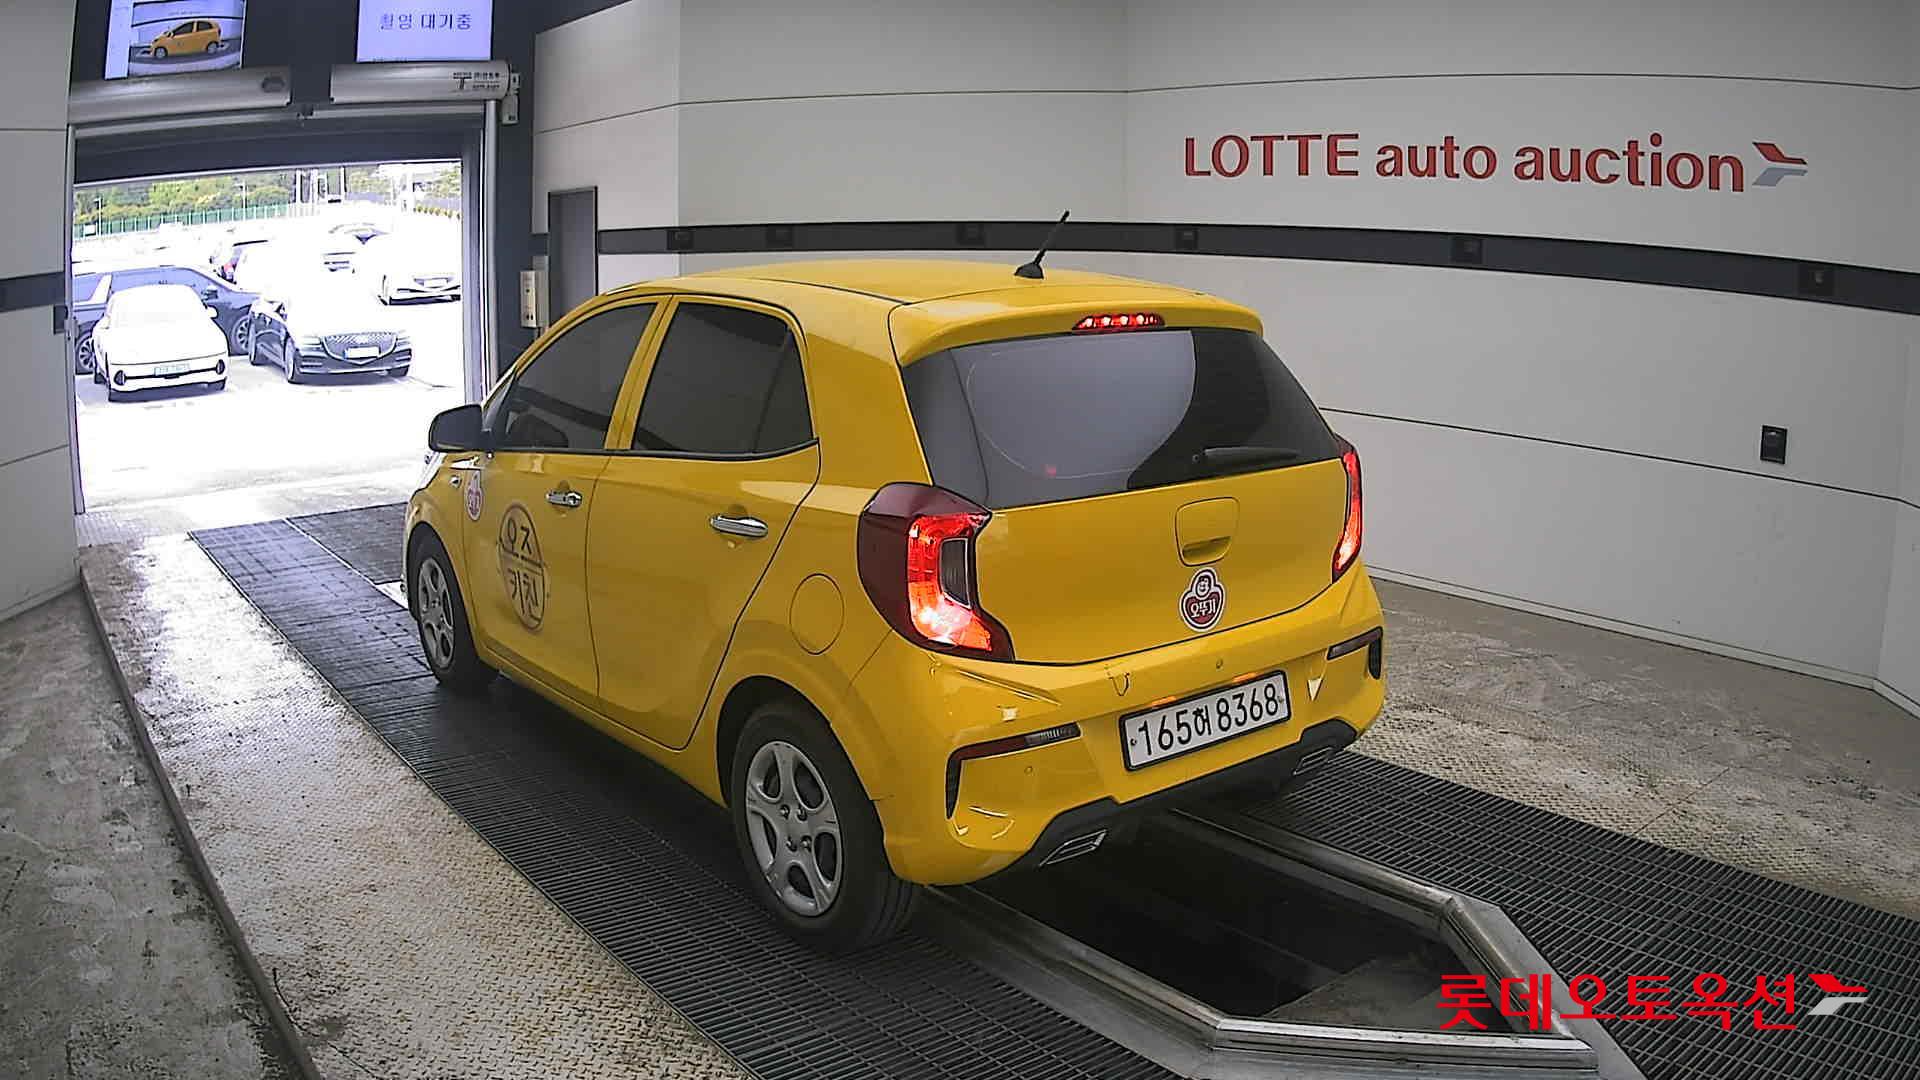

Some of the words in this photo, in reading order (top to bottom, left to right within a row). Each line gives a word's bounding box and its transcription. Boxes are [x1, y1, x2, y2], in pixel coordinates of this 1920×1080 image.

[421, 14, 472, 30] 대기중
[1185, 133, 1359, 177] LOTTE
[1375, 136, 1498, 179] auto
[1514, 132, 1745, 192] auction
[1190, 598, 1216, 618] 오뚜기
